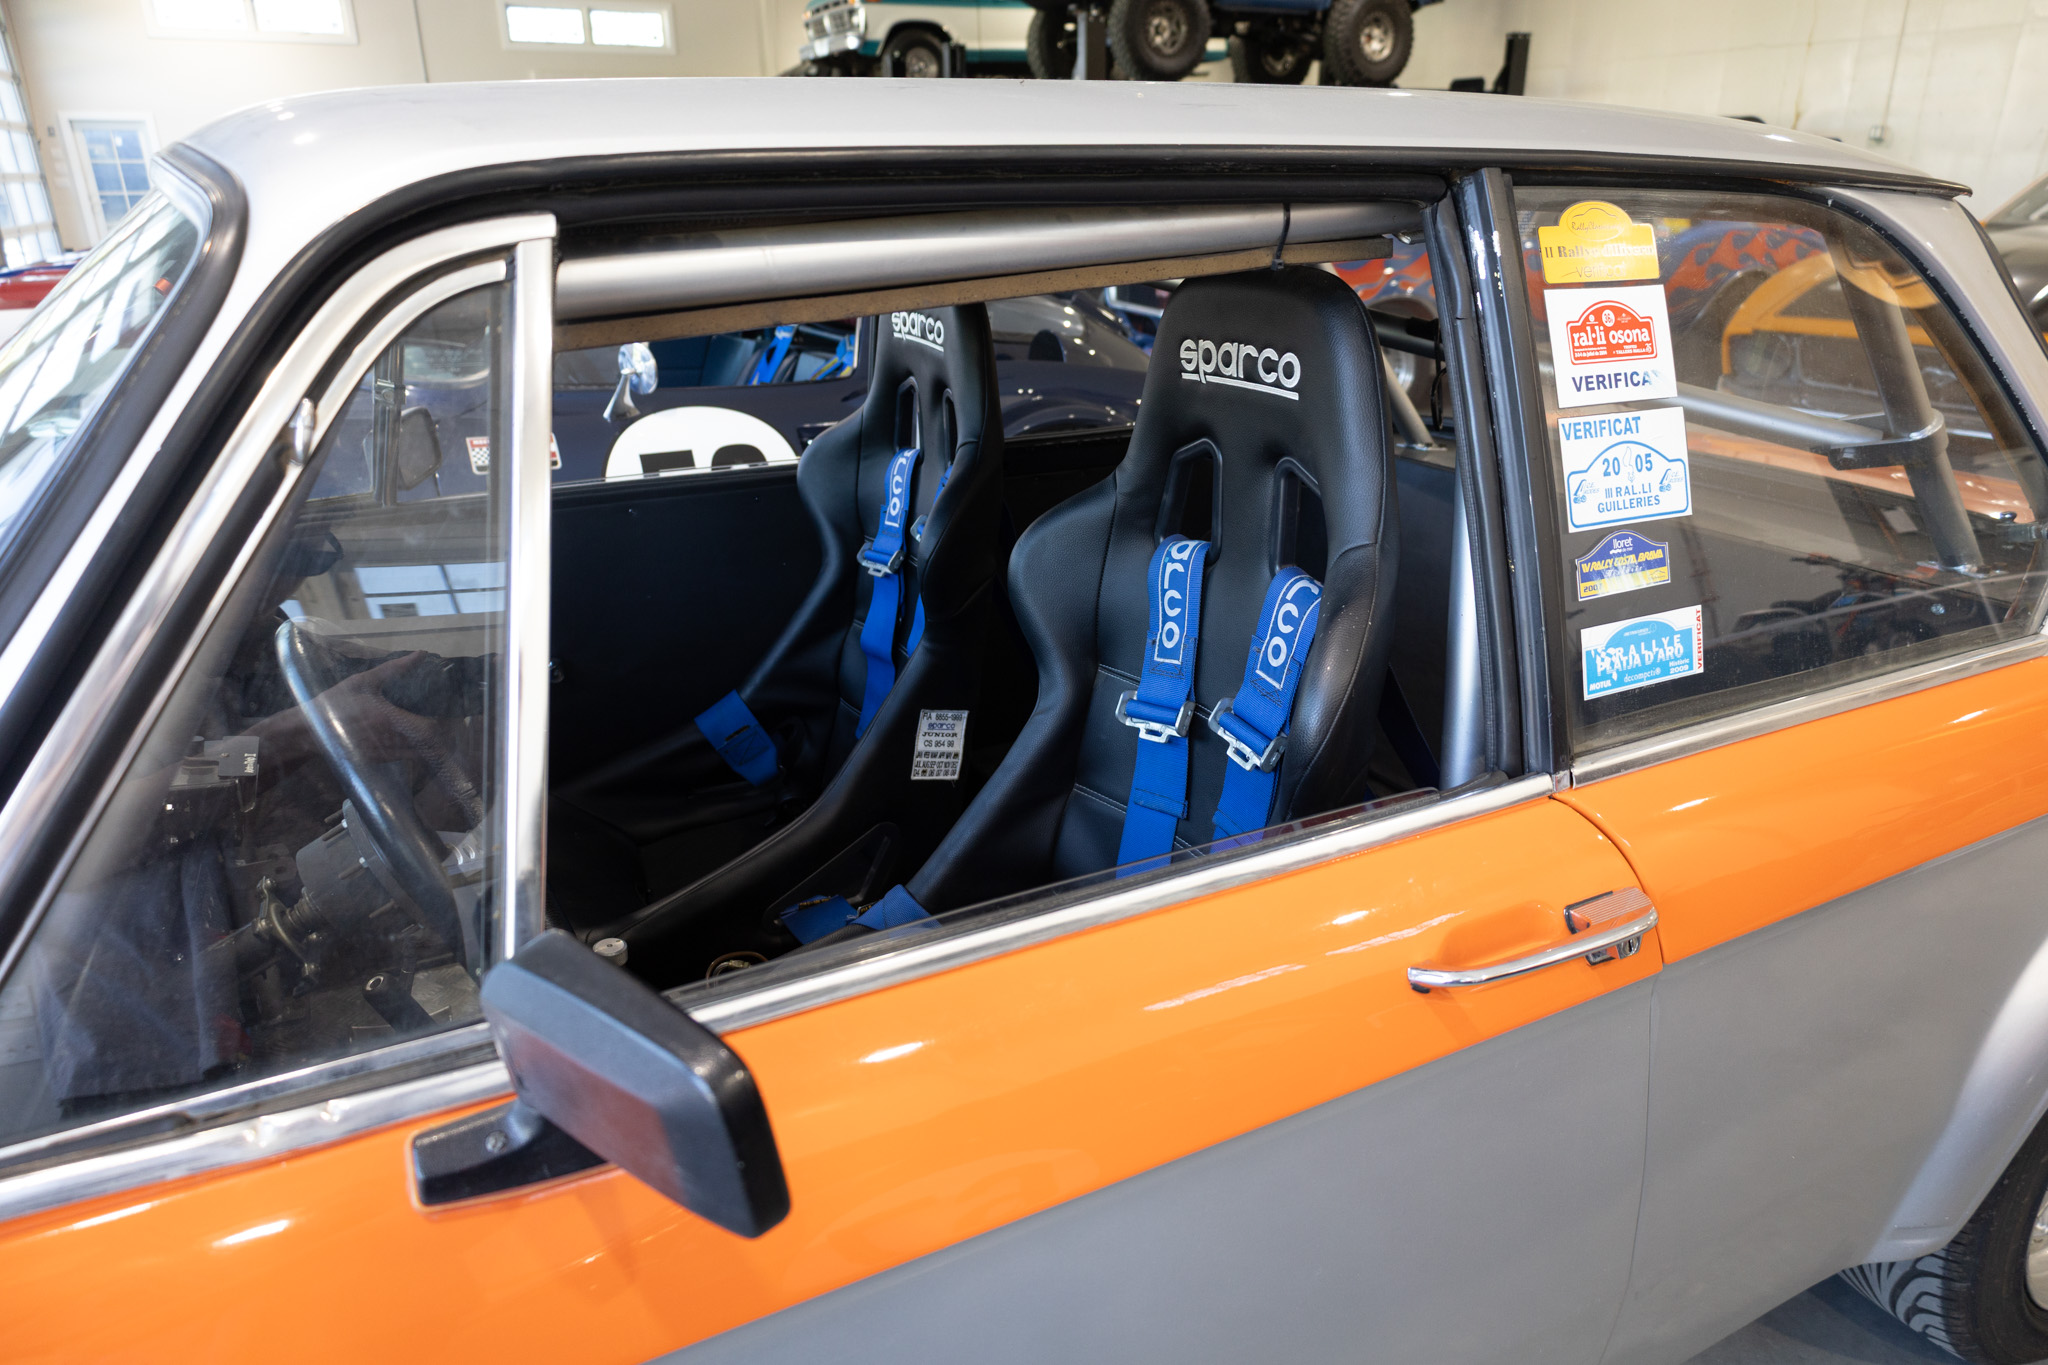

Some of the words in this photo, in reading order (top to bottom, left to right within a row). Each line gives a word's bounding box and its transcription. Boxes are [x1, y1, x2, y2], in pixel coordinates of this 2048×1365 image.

[891, 311, 945, 345] sparco
[1609, 328, 1650, 344] osona
[1179, 338, 1301, 389] sparco
[1571, 370, 1656, 393] VERIFICA
[1561, 416, 1641, 441] VERIFICAT
[1602, 456, 1621, 477] 20
[1634, 452, 1653, 473] 05
[1604, 487, 1613, 499] III
[1615, 482, 1652, 498] RAL.LI
[1597, 494, 1661, 513] GUILLERIES
[1612, 537, 1634, 549] lloret
[1590, 558, 1614, 572] RALLY
[1613, 554, 1637, 567] COSTA
[1637, 548, 1664, 562] BRAVA
[1695, 608, 1703, 670] VERIFICAT
[1596, 653, 1642, 677] PLATJA
[1645, 643, 1684, 666] D'ARO
[1669, 664, 1689, 675] 2009
[1589, 679, 1612, 692] MOTUL
[927, 722, 956, 731] sparco
[923, 740, 933, 748] CS
